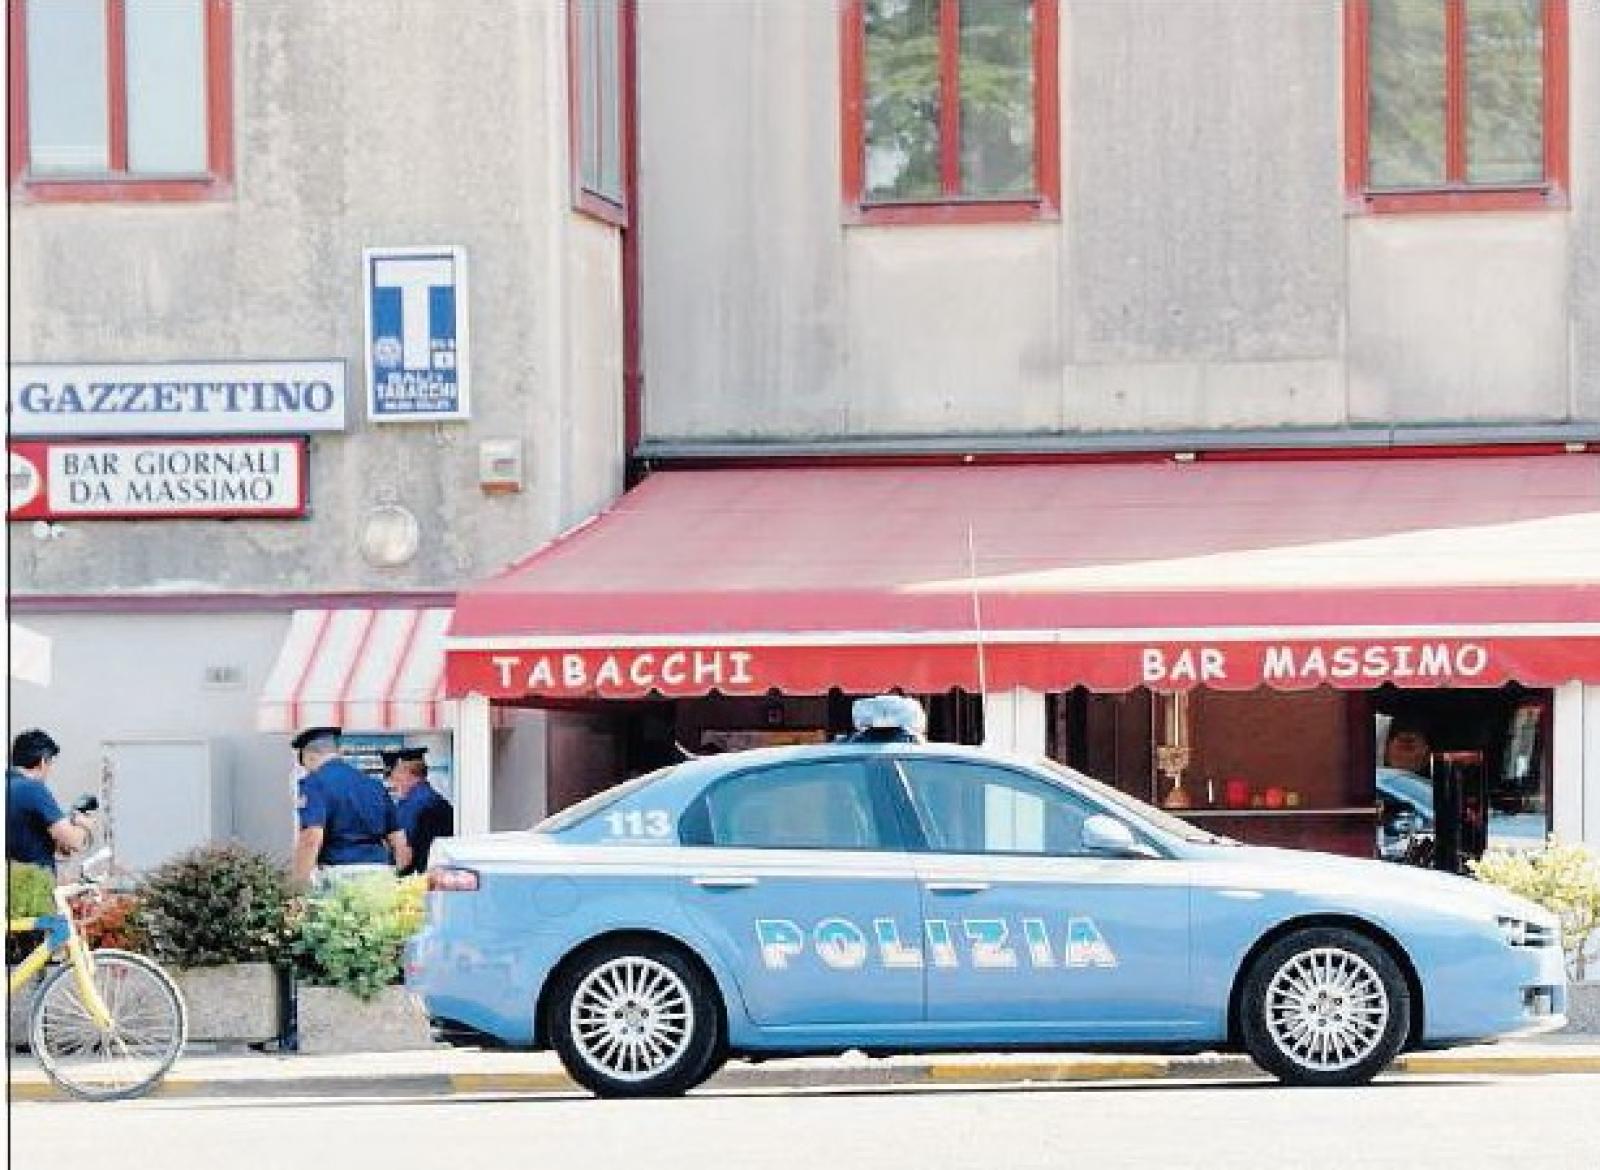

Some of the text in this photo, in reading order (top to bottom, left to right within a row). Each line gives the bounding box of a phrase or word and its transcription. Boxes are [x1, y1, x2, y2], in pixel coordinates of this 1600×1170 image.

[374, 261, 455, 370] T
[20, 382, 334, 413] GAZZETTINO
[64, 451, 280, 475] BAR GIORNALI
[69, 477, 274, 503] DA MASSIMO
[492, 651, 754, 689] TABACCHI
[1143, 643, 1488, 682] BAR MASSIMO
[604, 809, 671, 838] 113
[755, 918, 1119, 969] POLIZIA
